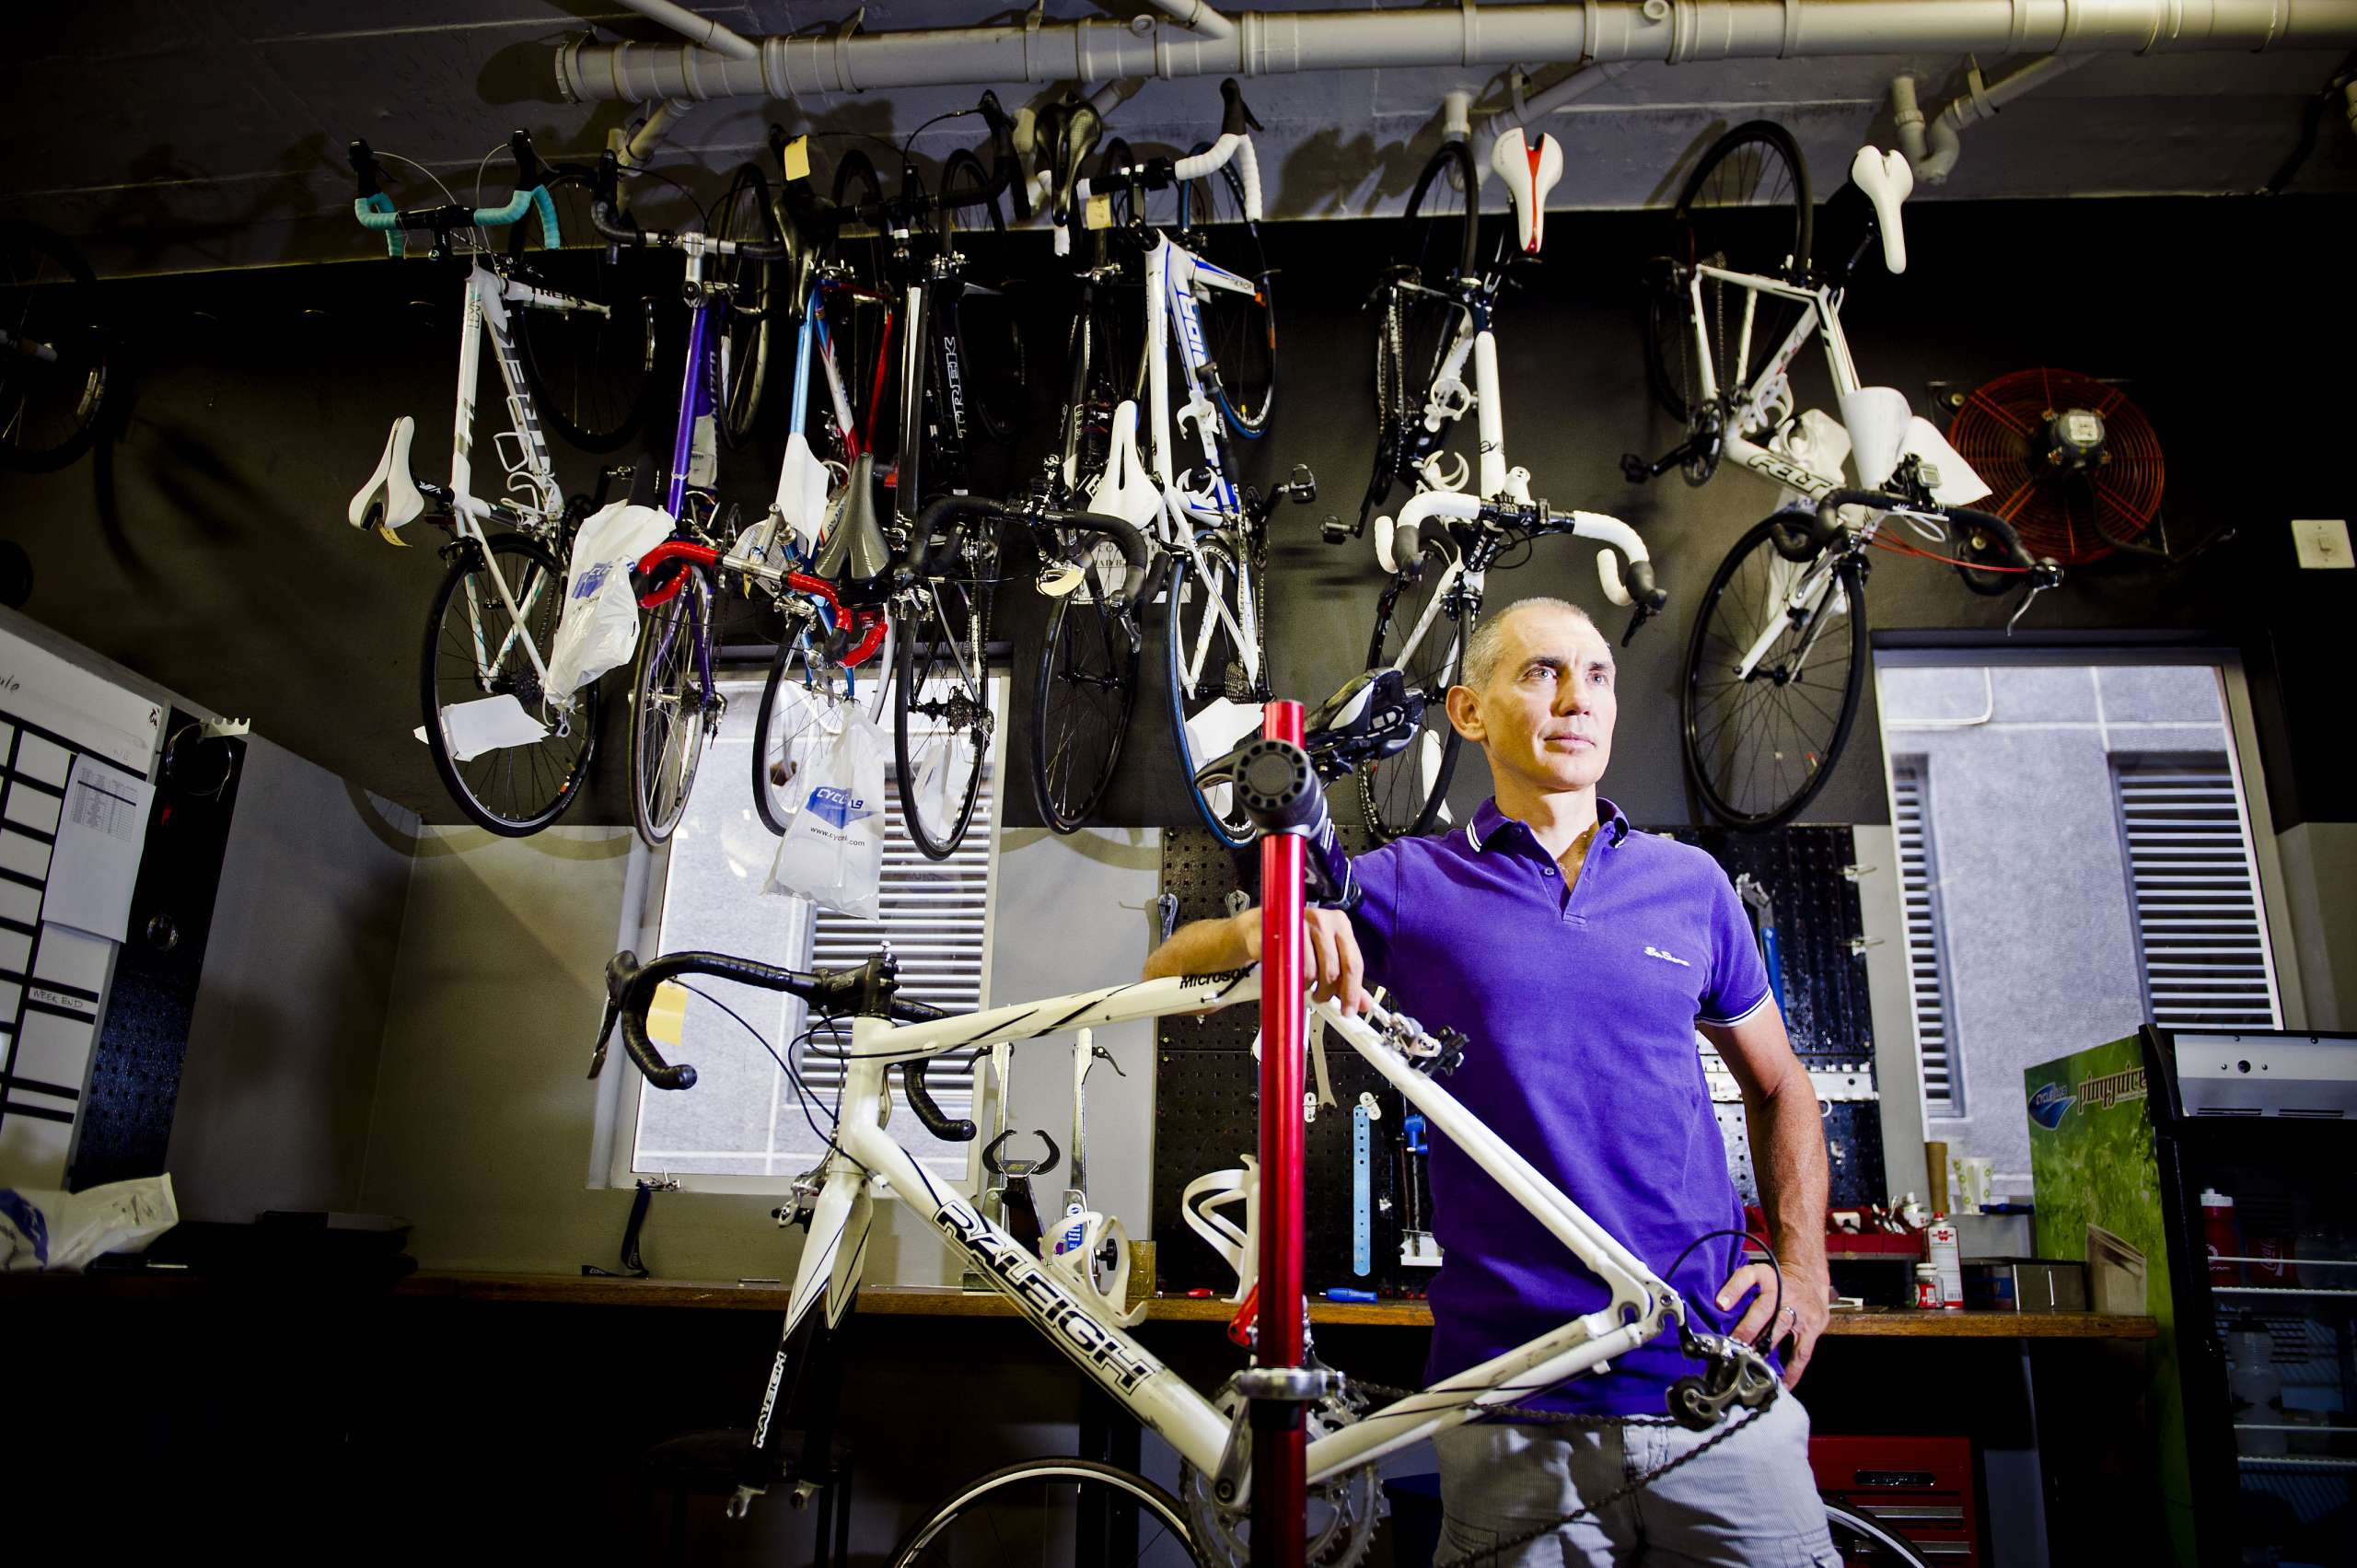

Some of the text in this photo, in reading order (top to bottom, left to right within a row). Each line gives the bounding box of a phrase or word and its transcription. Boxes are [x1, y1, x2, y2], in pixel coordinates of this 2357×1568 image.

[944, 335, 967, 438] TREK
[1749, 454, 1834, 494] FELT
[61, 996, 83, 1008] END
[932, 1200, 1156, 1396] RALEIGH
[752, 1350, 787, 1449] RALEIGH
